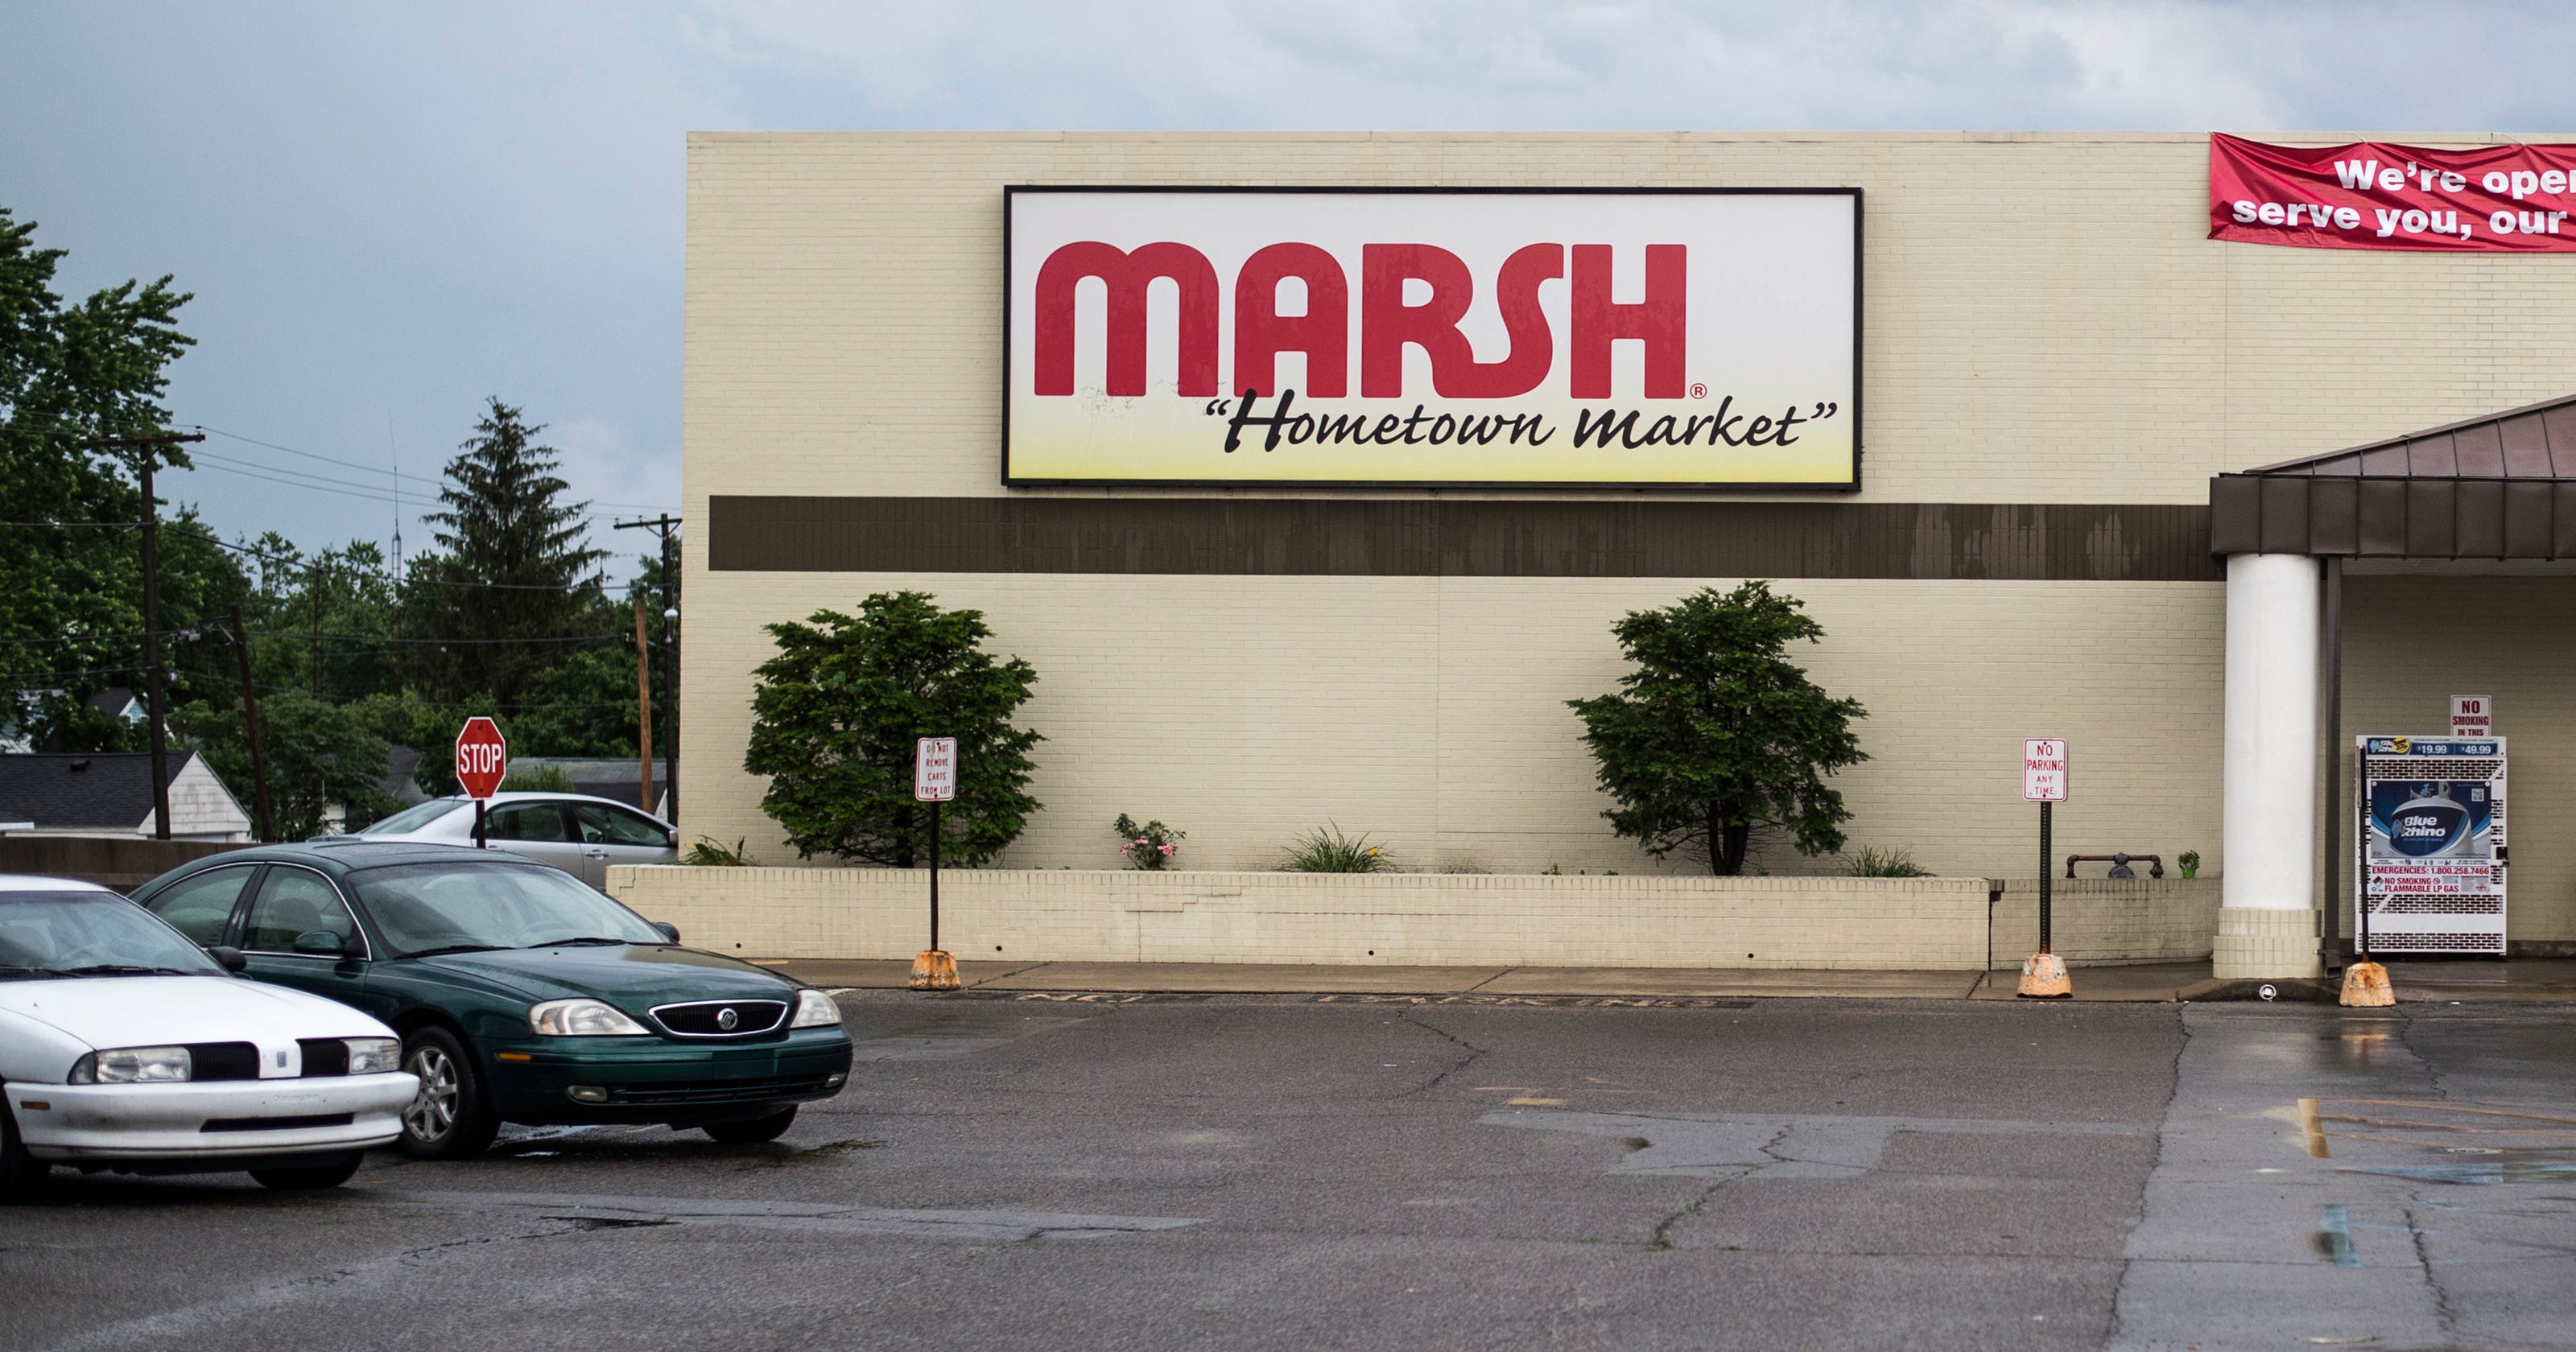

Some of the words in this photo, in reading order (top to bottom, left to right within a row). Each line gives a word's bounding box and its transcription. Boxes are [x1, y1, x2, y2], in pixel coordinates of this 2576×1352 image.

[2334, 159, 2467, 193] We’re
[2482, 170, 2576, 200] ope
[2232, 200, 2360, 229] serve
[2375, 208, 2471, 241] you,
[2489, 210, 2568, 234] our
[1035, 241, 1686, 399] MARSH
[2462, 700, 2480, 714] NO
[2453, 715, 2489, 726] SMOKING
[2458, 728, 2466, 736] IN
[2468, 728, 2484, 736] THIS
[2037, 744, 2053, 756] NO
[460, 743, 502, 774] STOP
[926, 758, 948, 767] REMOVE
[2027, 759, 2064, 771] PARKING
[927, 773, 947, 781] CARTS
[2037, 775, 2053, 783] ANY
[921, 785, 938, 795] FROM
[939, 785, 951, 794] LOT
[2035, 786, 2054, 795] TIME
[2404, 815, 2438, 826] Blue
[2372, 867, 2429, 875] EMERGENCIES:
[2430, 867, 2490, 875] 1.800.258.7466
